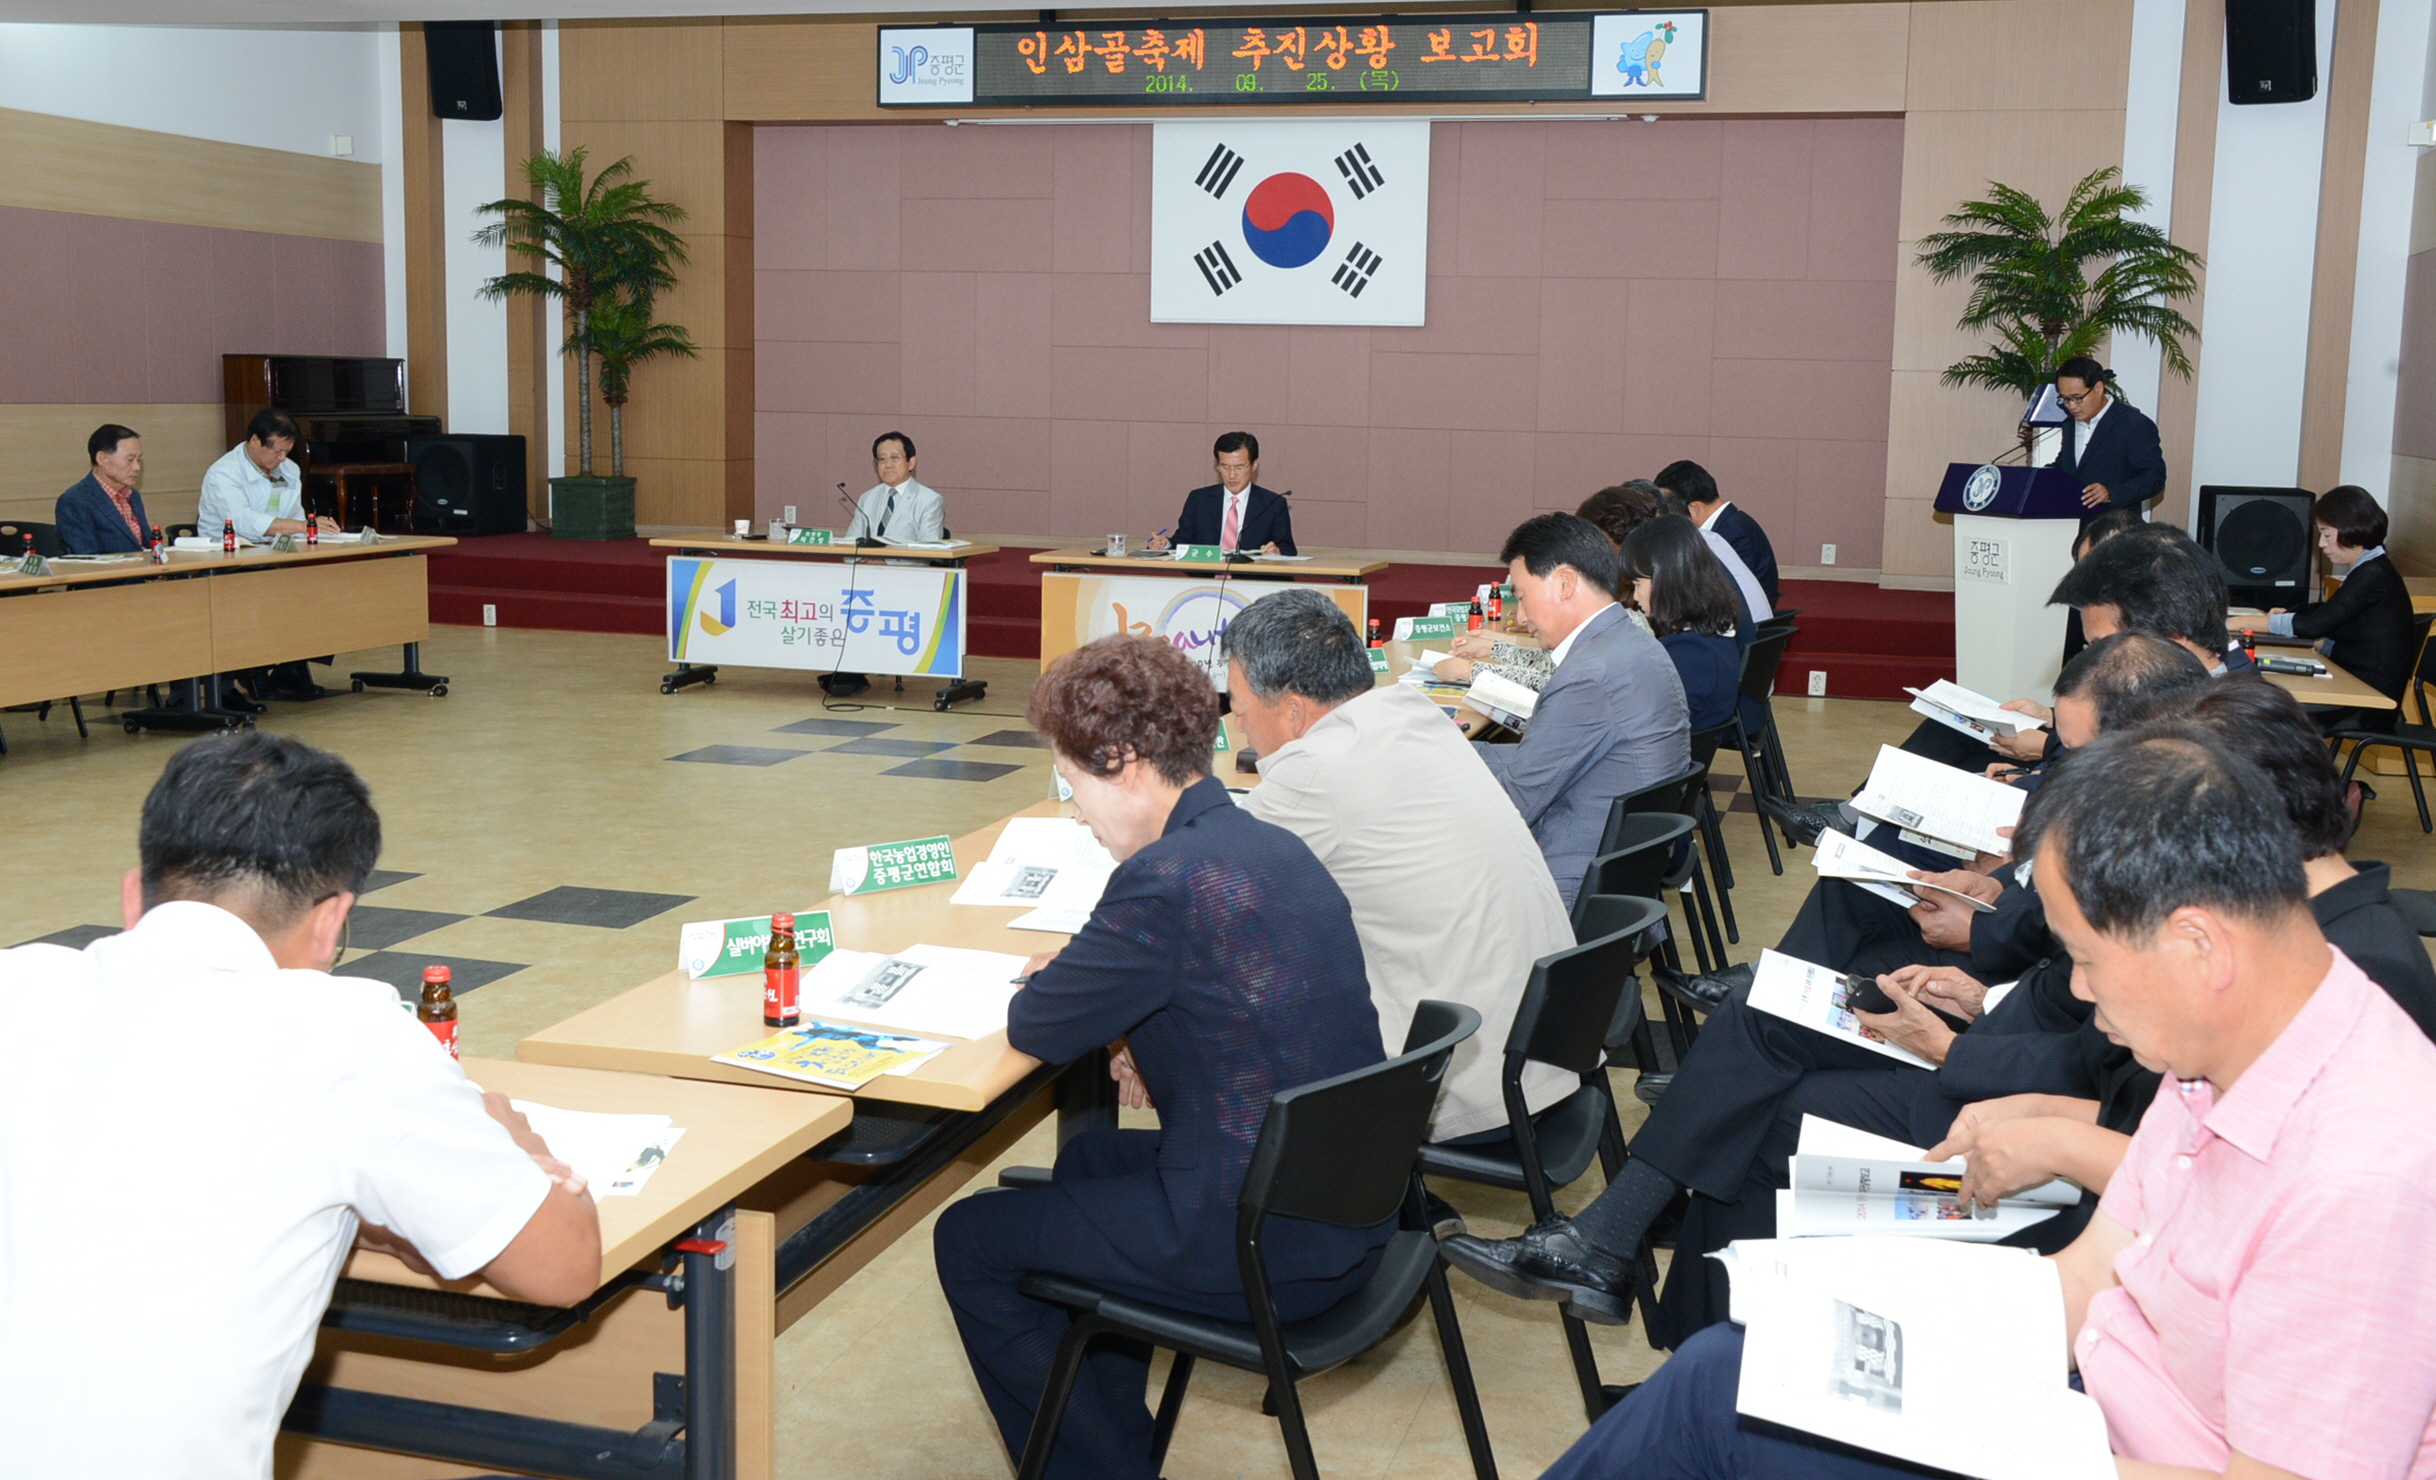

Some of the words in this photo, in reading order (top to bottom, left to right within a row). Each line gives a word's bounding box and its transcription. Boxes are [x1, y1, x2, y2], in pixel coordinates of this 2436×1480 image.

[1018, 28, 1204, 74] 인삼골축제
[1232, 25, 1396, 71] 추진상황
[1420, 22, 1538, 67] 보고회
[930, 54, 965, 76] 증평군
[917, 77, 938, 86] Jeung
[939, 77, 965, 86] Pyeong
[1145, 74, 1194, 93] 2014.
[1306, 72, 1336, 91] 25.
[1359, 70, 1400, 91] (목)
[1970, 541, 2000, 567] 증평군
[747, 600, 778, 620] 전국
[780, 599, 834, 624] 최고의
[840, 589, 921, 656] 증평
[869, 841, 951, 867] 한국농업경영인
[873, 858, 955, 886] 증평군연합회
[726, 927, 831, 958] 실버야연구회
